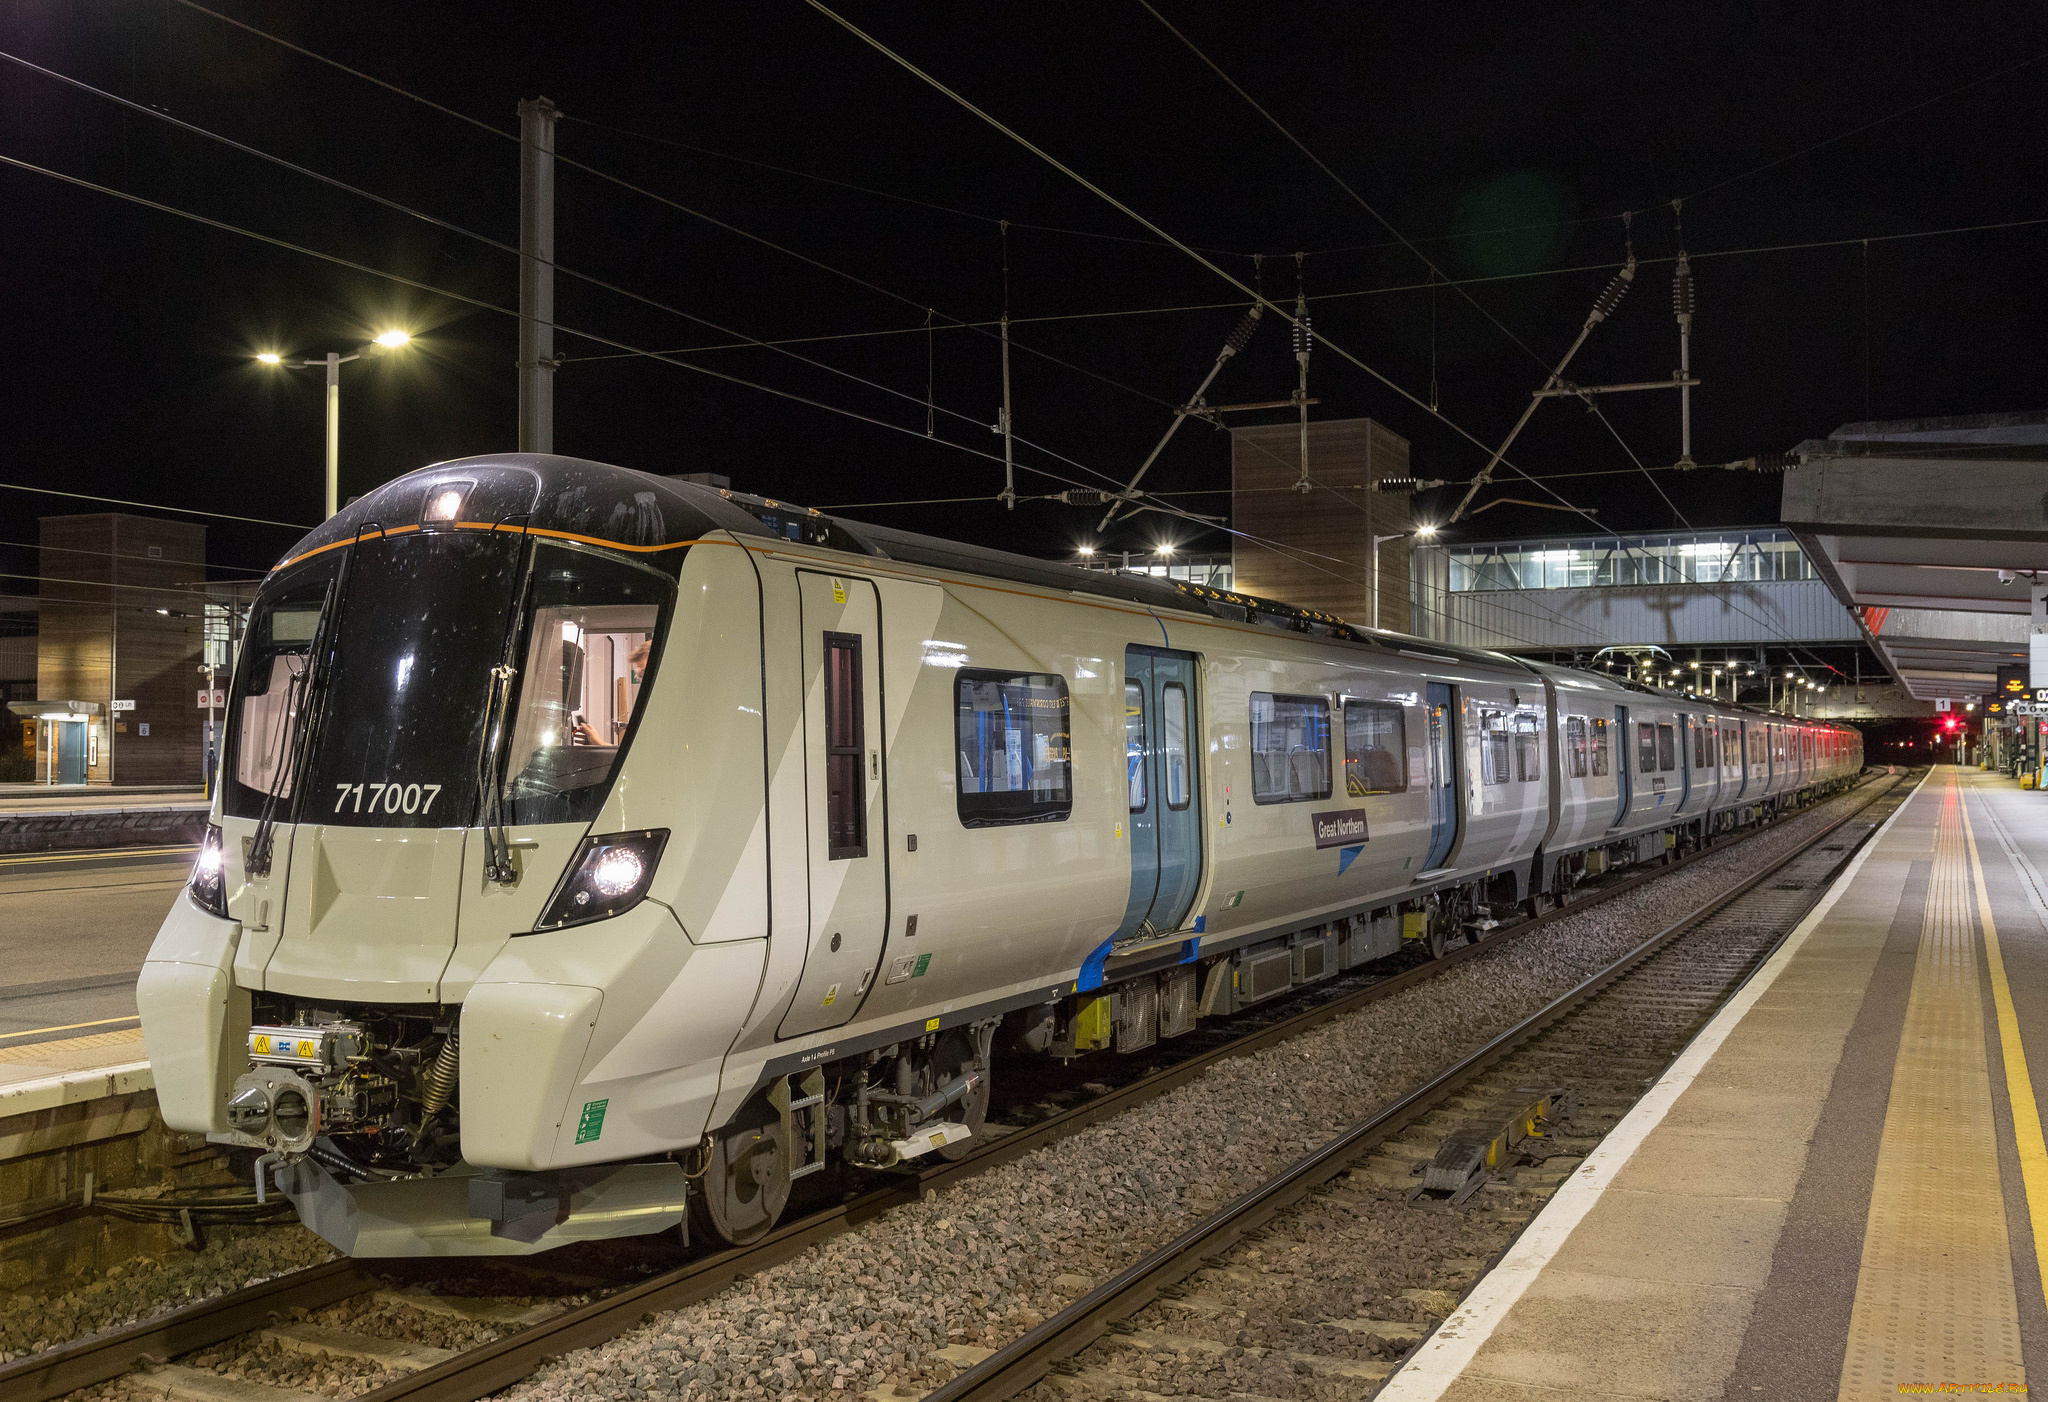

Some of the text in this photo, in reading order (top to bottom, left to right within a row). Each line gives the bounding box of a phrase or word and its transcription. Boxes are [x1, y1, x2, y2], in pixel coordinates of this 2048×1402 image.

[1940, 700, 1945, 709] 1
[142, 727, 147, 735] 6
[334, 783, 442, 815] 717007
[1318, 817, 1365, 839] Great Northern
